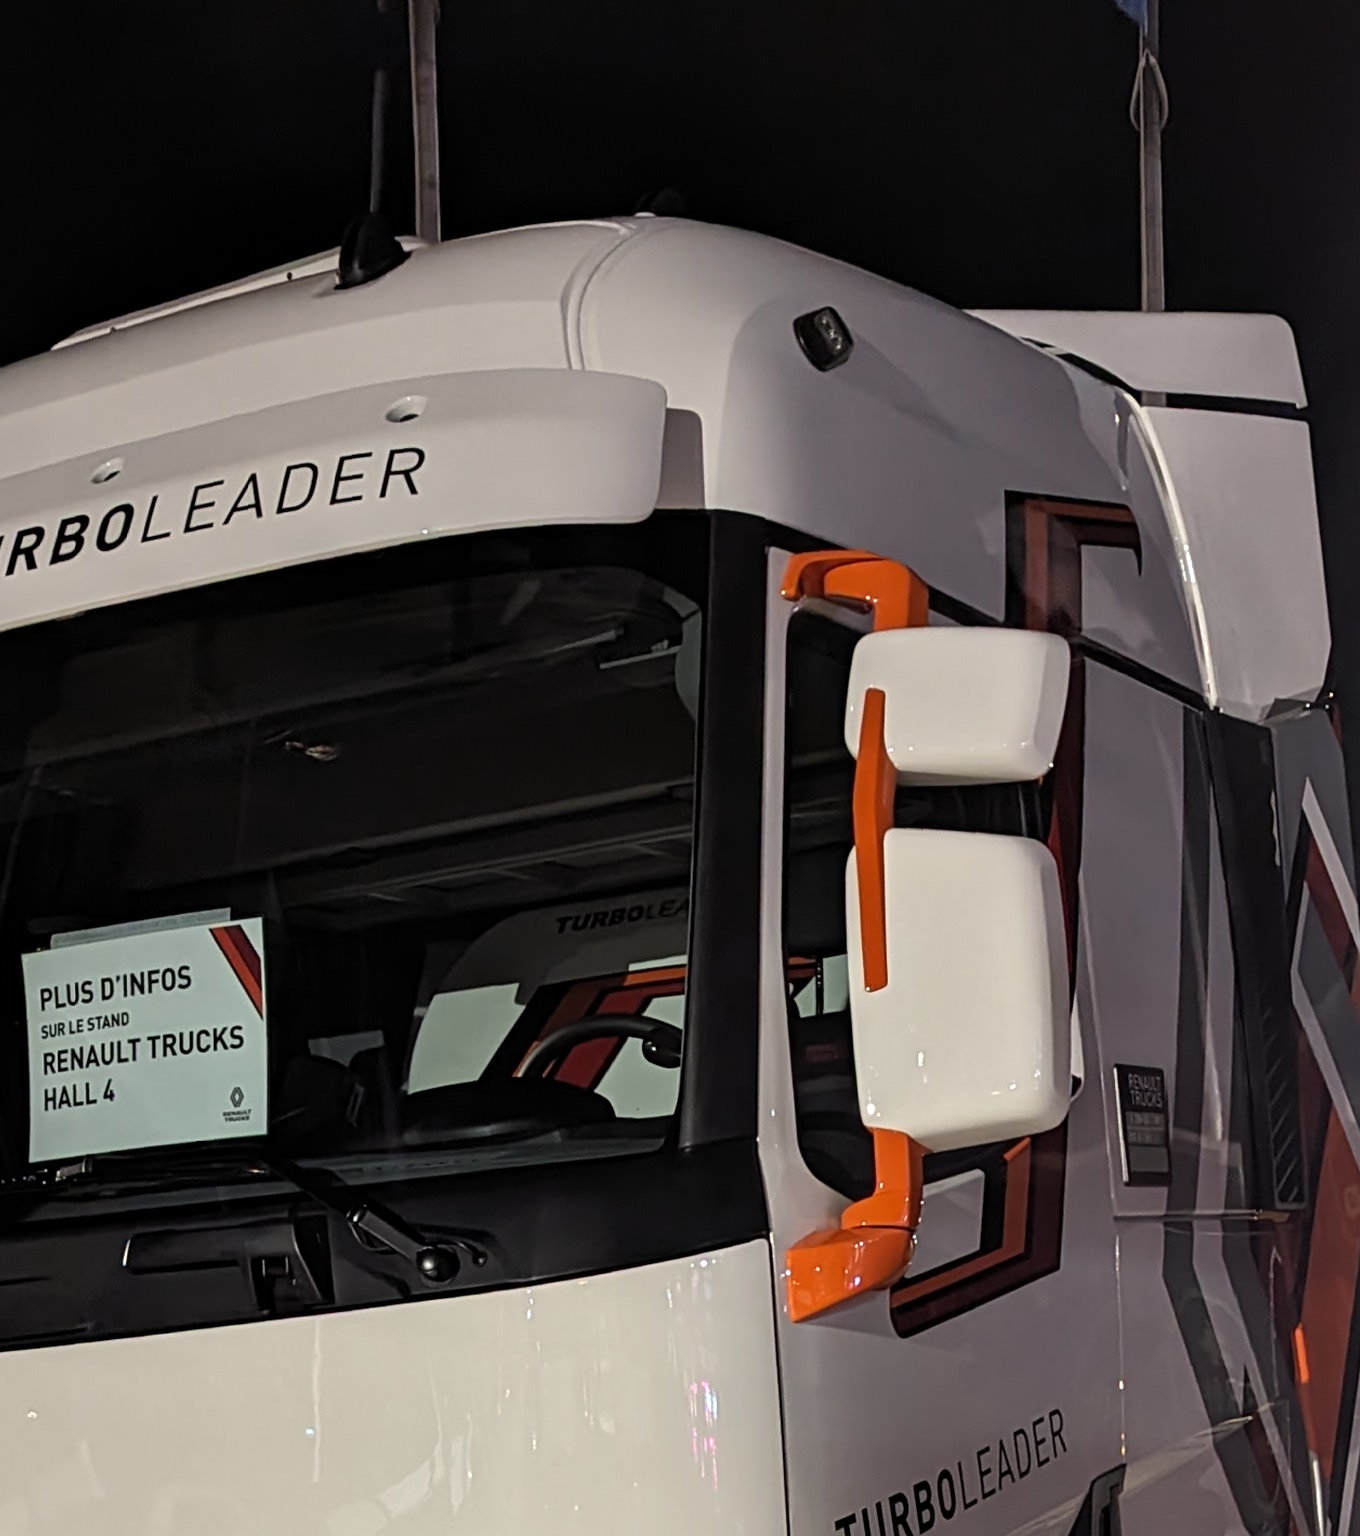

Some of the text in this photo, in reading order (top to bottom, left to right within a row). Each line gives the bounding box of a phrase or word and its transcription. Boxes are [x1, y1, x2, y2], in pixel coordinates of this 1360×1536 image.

[40, 965, 192, 1011] PLUS D'INFOS
[41, 1011, 130, 1040] SUR LE STAND
[43, 1025, 245, 1075] RENAULT TRUCKS
[44, 1078, 115, 1112] HALL 4
[1129, 1089, 1164, 1108] TRUCKS
